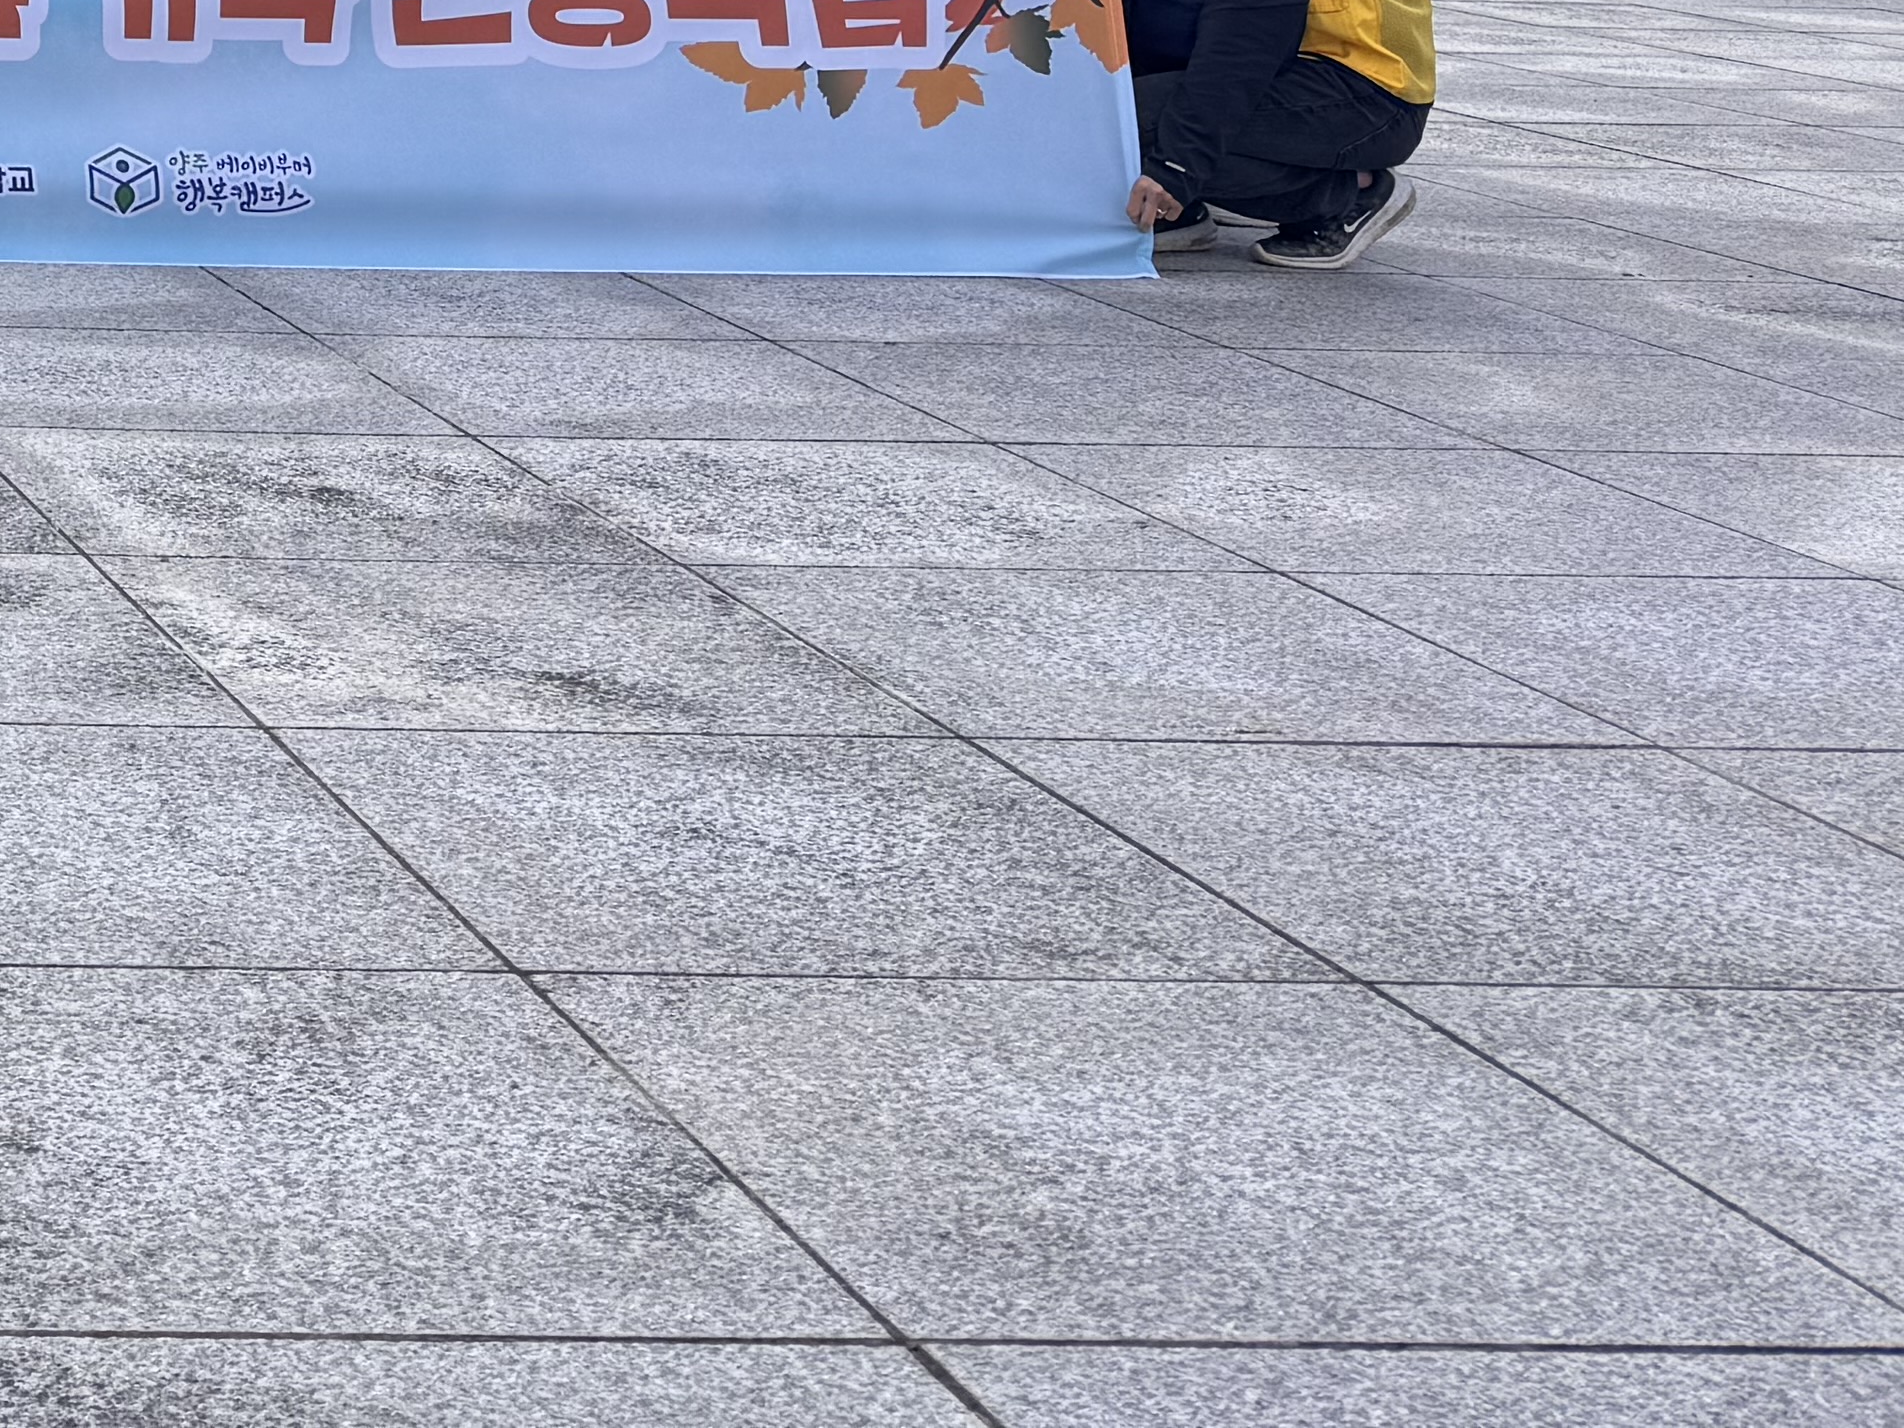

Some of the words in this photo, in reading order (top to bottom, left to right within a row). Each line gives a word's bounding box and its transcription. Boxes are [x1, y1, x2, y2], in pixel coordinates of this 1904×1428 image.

[168, 150, 210, 172] 양주
[215, 151, 313, 176] 베이비부머
[175, 180, 312, 214] 행복캠퍼스
